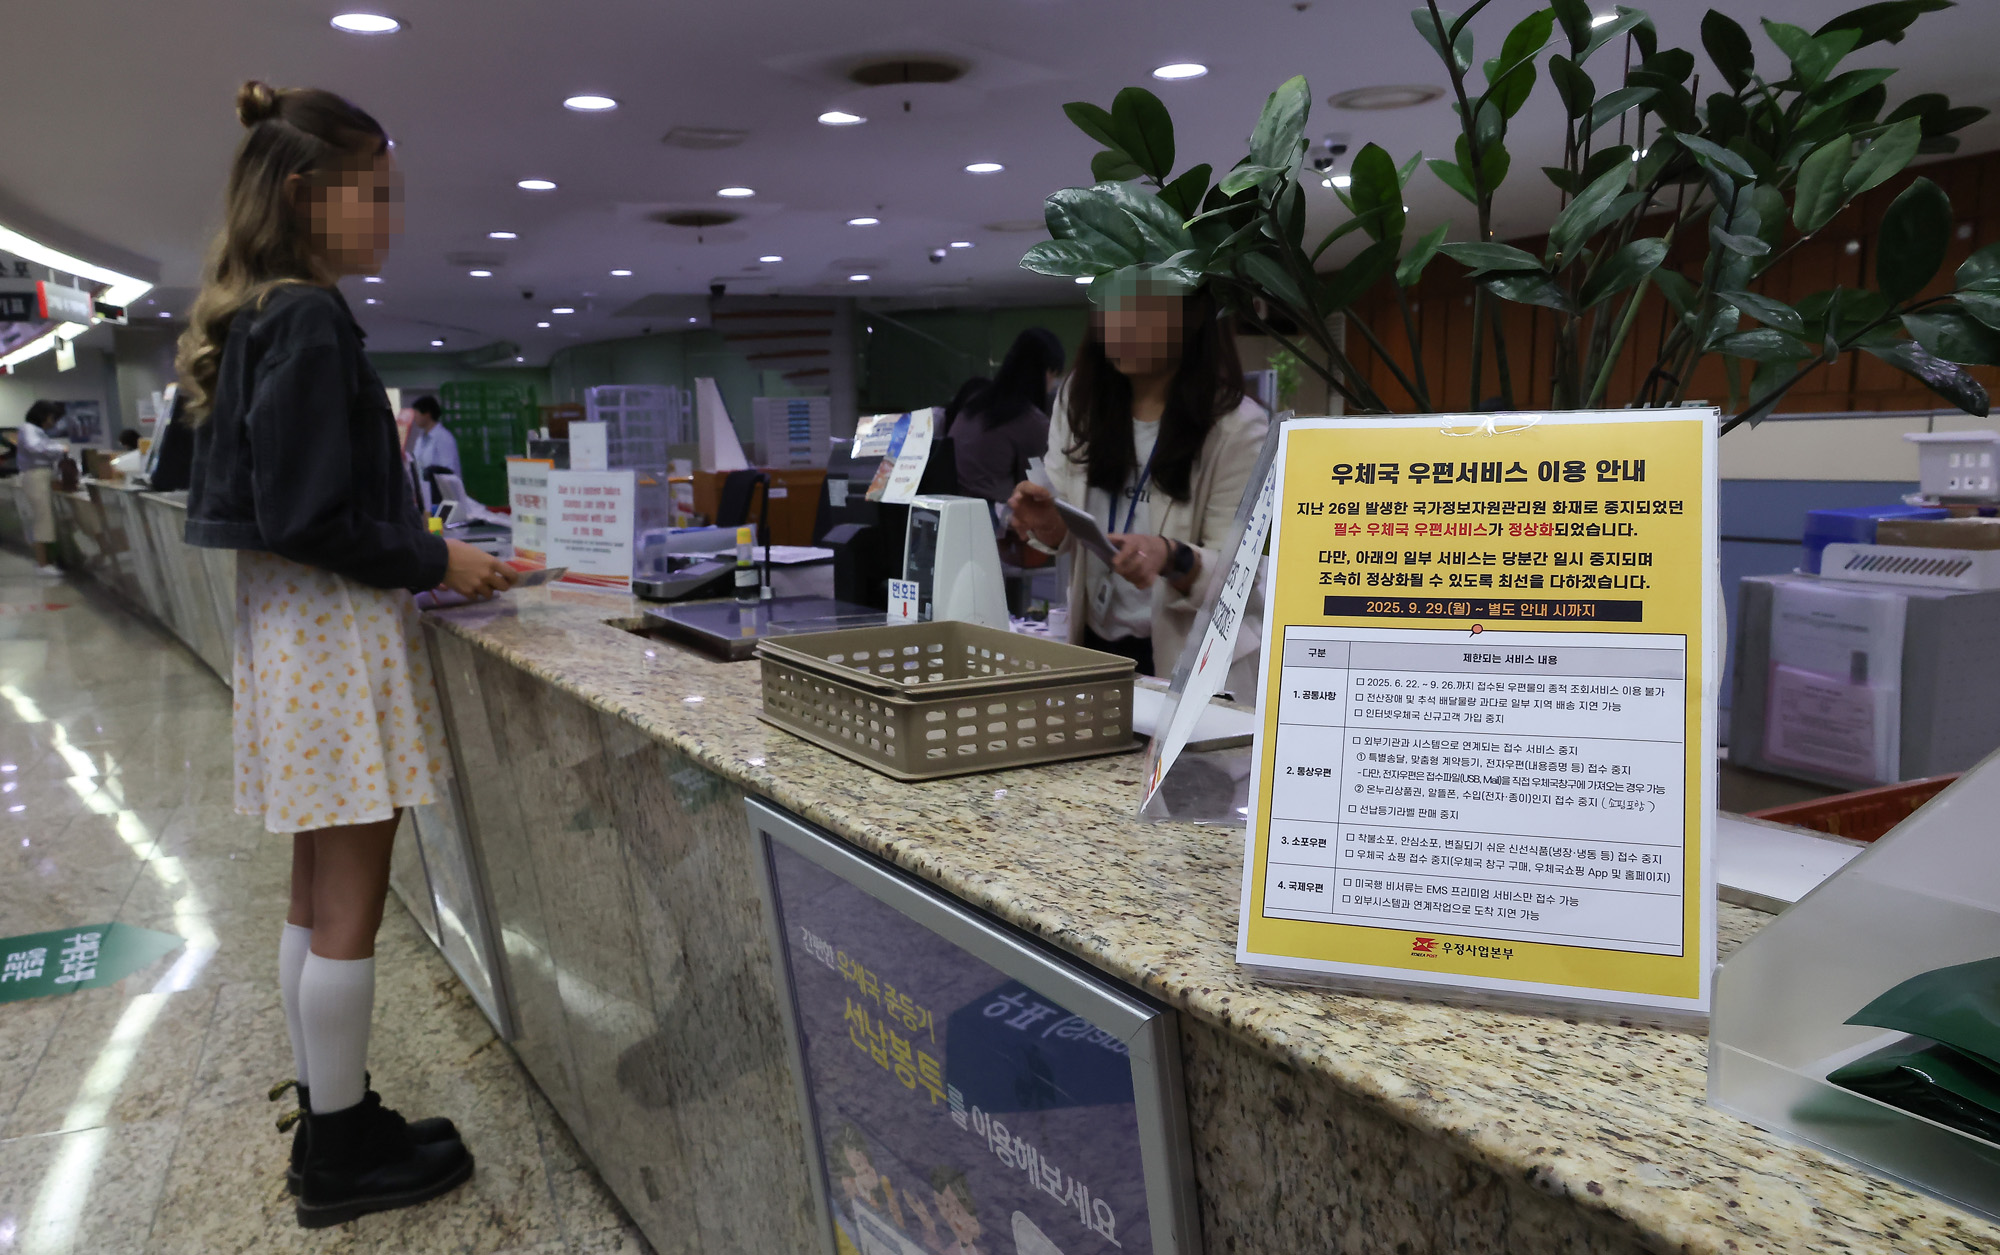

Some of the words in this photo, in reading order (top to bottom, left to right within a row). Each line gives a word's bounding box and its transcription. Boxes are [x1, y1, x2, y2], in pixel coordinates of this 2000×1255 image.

[1331, 462, 1399, 485] 우체국
[1408, 461, 1527, 484] 우편서비스
[1537, 460, 1586, 483] 이용
[1596, 459, 1645, 482] 안내
[1296, 502, 1324, 515] 지난
[1328, 501, 1360, 515] 26일
[1365, 501, 1408, 515] 발생한
[1412, 500, 1546, 515] 국가정보자원관리원
[1552, 500, 1598, 514] 화재로
[1604, 500, 1683, 514] 중지되었던
[1334, 522, 1361, 536] 필수
[1366, 522, 1409, 536] 우체국
[1414, 522, 1503, 536] 우편서비스가
[1508, 522, 1637, 537] 정상화되었습니다.
[1318, 550, 1350, 565] 다만,
[1356, 550, 1397, 564] 아래의
[1404, 551, 1431, 565] 일부
[1437, 551, 1496, 565] 서비스는
[1502, 551, 1548, 566] 당분간
[1553, 551, 1583, 566] 일시
[1589, 552, 1652, 566] 중지되며
[1318, 571, 1360, 586] 조속히
[1366, 572, 1423, 587] 정상화될
[1429, 573, 1443, 587] 수
[1449, 573, 1493, 588] 있도록
[1498, 573, 1544, 588] 최선을
[1550, 574, 1650, 589] 다하겠습니다.
[892, 582, 916, 600] 번호표
[1367, 602, 1404, 614] 2025.
[1408, 602, 1420, 613] 9.
[1425, 601, 1470, 616] 29.(월)
[1488, 603, 1515, 616] 별도
[1520, 603, 1547, 616] 안내
[1552, 604, 1594, 617] 시까지
[1308, 648, 1326, 658] 구분
[1462, 653, 1501, 663] 제한되는
[1504, 654, 1534, 664] 서비스
[1538, 655, 1557, 665] 내용
[1293, 690, 1300, 698] 1.
[1302, 690, 1336, 701] 공통사항
[1367, 677, 1392, 687] 2025.
[1394, 678, 1402, 687] 6.
[1405, 679, 1419, 688] 22.
[1430, 680, 1438, 689] 9.
[1441, 680, 1474, 690] 26.까지
[1477, 681, 1504, 692] 접수된
[1507, 682, 1545, 693] 우편물의
[1548, 683, 1567, 693] 종적
[1570, 684, 1618, 695] 조회서비스
[1622, 685, 1641, 696] 이용
[1645, 687, 1665, 697] 불가
[1367, 693, 1402, 703] 전산장애
[1406, 694, 1414, 704] 및
[1417, 695, 1435, 705] 추석
[1439, 696, 1476, 706] 배달물량
[1479, 697, 1507, 707] 과다로
[1511, 698, 1530, 708] 일부
[1533, 699, 1552, 709] 지역
[1556, 700, 1575, 710] 배송
[1578, 700, 1598, 711] 지연
[1602, 701, 1621, 712] 가능
[1365, 708, 1420, 720] 인터넷우체국
[1423, 711, 1460, 722] 신규고객
[1463, 712, 1482, 723] 가입
[1485, 713, 1504, 723] 중지
[1364, 736, 1410, 747] 외부기관과
[1412, 739, 1459, 750] 시스템으로
[1462, 741, 1500, 752] 연계되는
[1503, 743, 1522, 753] 접수
[1525, 744, 1554, 754] 서비스
[1558, 745, 1577, 756] 중지
[1286, 766, 1294, 775] 2.
[1297, 766, 1331, 777] 통상우편
[1368, 752, 1407, 764] 특별송달,
[1411, 754, 1438, 765] 맞춤형
[1442, 756, 1482, 768] 계약등기,
[1486, 758, 1567, 772] 전자우편(내용증명
[1571, 762, 1584, 773] 등)
[1588, 763, 1607, 774] 접수
[1611, 764, 1630, 775] 중지
[1362, 768, 1381, 778] 다만,
[1383, 769, 1424, 781] 전자우편은
[1512, 776, 1530, 786] 직접
[1531, 777, 1585, 789] 우체국창구에
[1587, 780, 1624, 792] 가져오는
[1626, 782, 1644, 793] 경우
[1646, 783, 1665, 794] 가능
[1366, 784, 1424, 797] 온누리상품권,
[1428, 787, 1459, 799] 알뜰폰,
[1555, 795, 1574, 806] 접수
[1578, 796, 1597, 807] 중지
[1359, 804, 1415, 817] 선납등기라벨
[1418, 808, 1436, 818] 판매
[1440, 809, 1458, 820] 중지
[1281, 836, 1289, 844] 3.
[1291, 836, 1326, 848] 소포우편
[1358, 833, 1397, 845] 착불소포,
[1400, 836, 1441, 848] 안심소포,
[1444, 839, 1482, 851] 변질되기
[1486, 842, 1505, 853] 쉬운
[1600, 850, 1614, 861] 등)
[1617, 851, 1637, 863] 접수
[1641, 853, 1661, 864] 중지
[1357, 849, 1384, 861] 우체국
[1387, 852, 1405, 862] 쇼핑
[1409, 853, 1427, 864] 접수
[1431, 854, 1482, 868] 중지(우체국
[1486, 859, 1504, 870] 창구
[1508, 860, 1531, 872] 구매,
[1534, 862, 1584, 876] 우체국쇼핑
[1587, 867, 1608, 879] App
[1611, 868, 1621, 879] 및
[1625, 869, 1670, 883] 홈페이지)
[1277, 880, 1286, 889] 4.
[1288, 881, 1323, 893] 국제우편
[1355, 878, 1382, 890] 미국행
[1386, 881, 1423, 893] 비서류는
[1426, 884, 1448, 895] EMS
[1451, 886, 1489, 899] 프리미엄
[1492, 890, 1533, 903] 서비스만
[1536, 893, 1555, 904] 접수
[1559, 895, 1579, 907] 가능
[1354, 895, 1410, 909] 외부시스템과
[1413, 900, 1470, 914] 연계작업으로
[1474, 905, 1494, 917] 도착
[1497, 907, 1516, 919] 지연
[1520, 909, 1539, 921] 가능
[1441, 942, 1513, 960] 우정사업본부
[837, 950, 881, 1005] 우체국
[884, 982, 936, 1043] 준등기
[971, 1105, 1122, 1249] 이용해보세요
